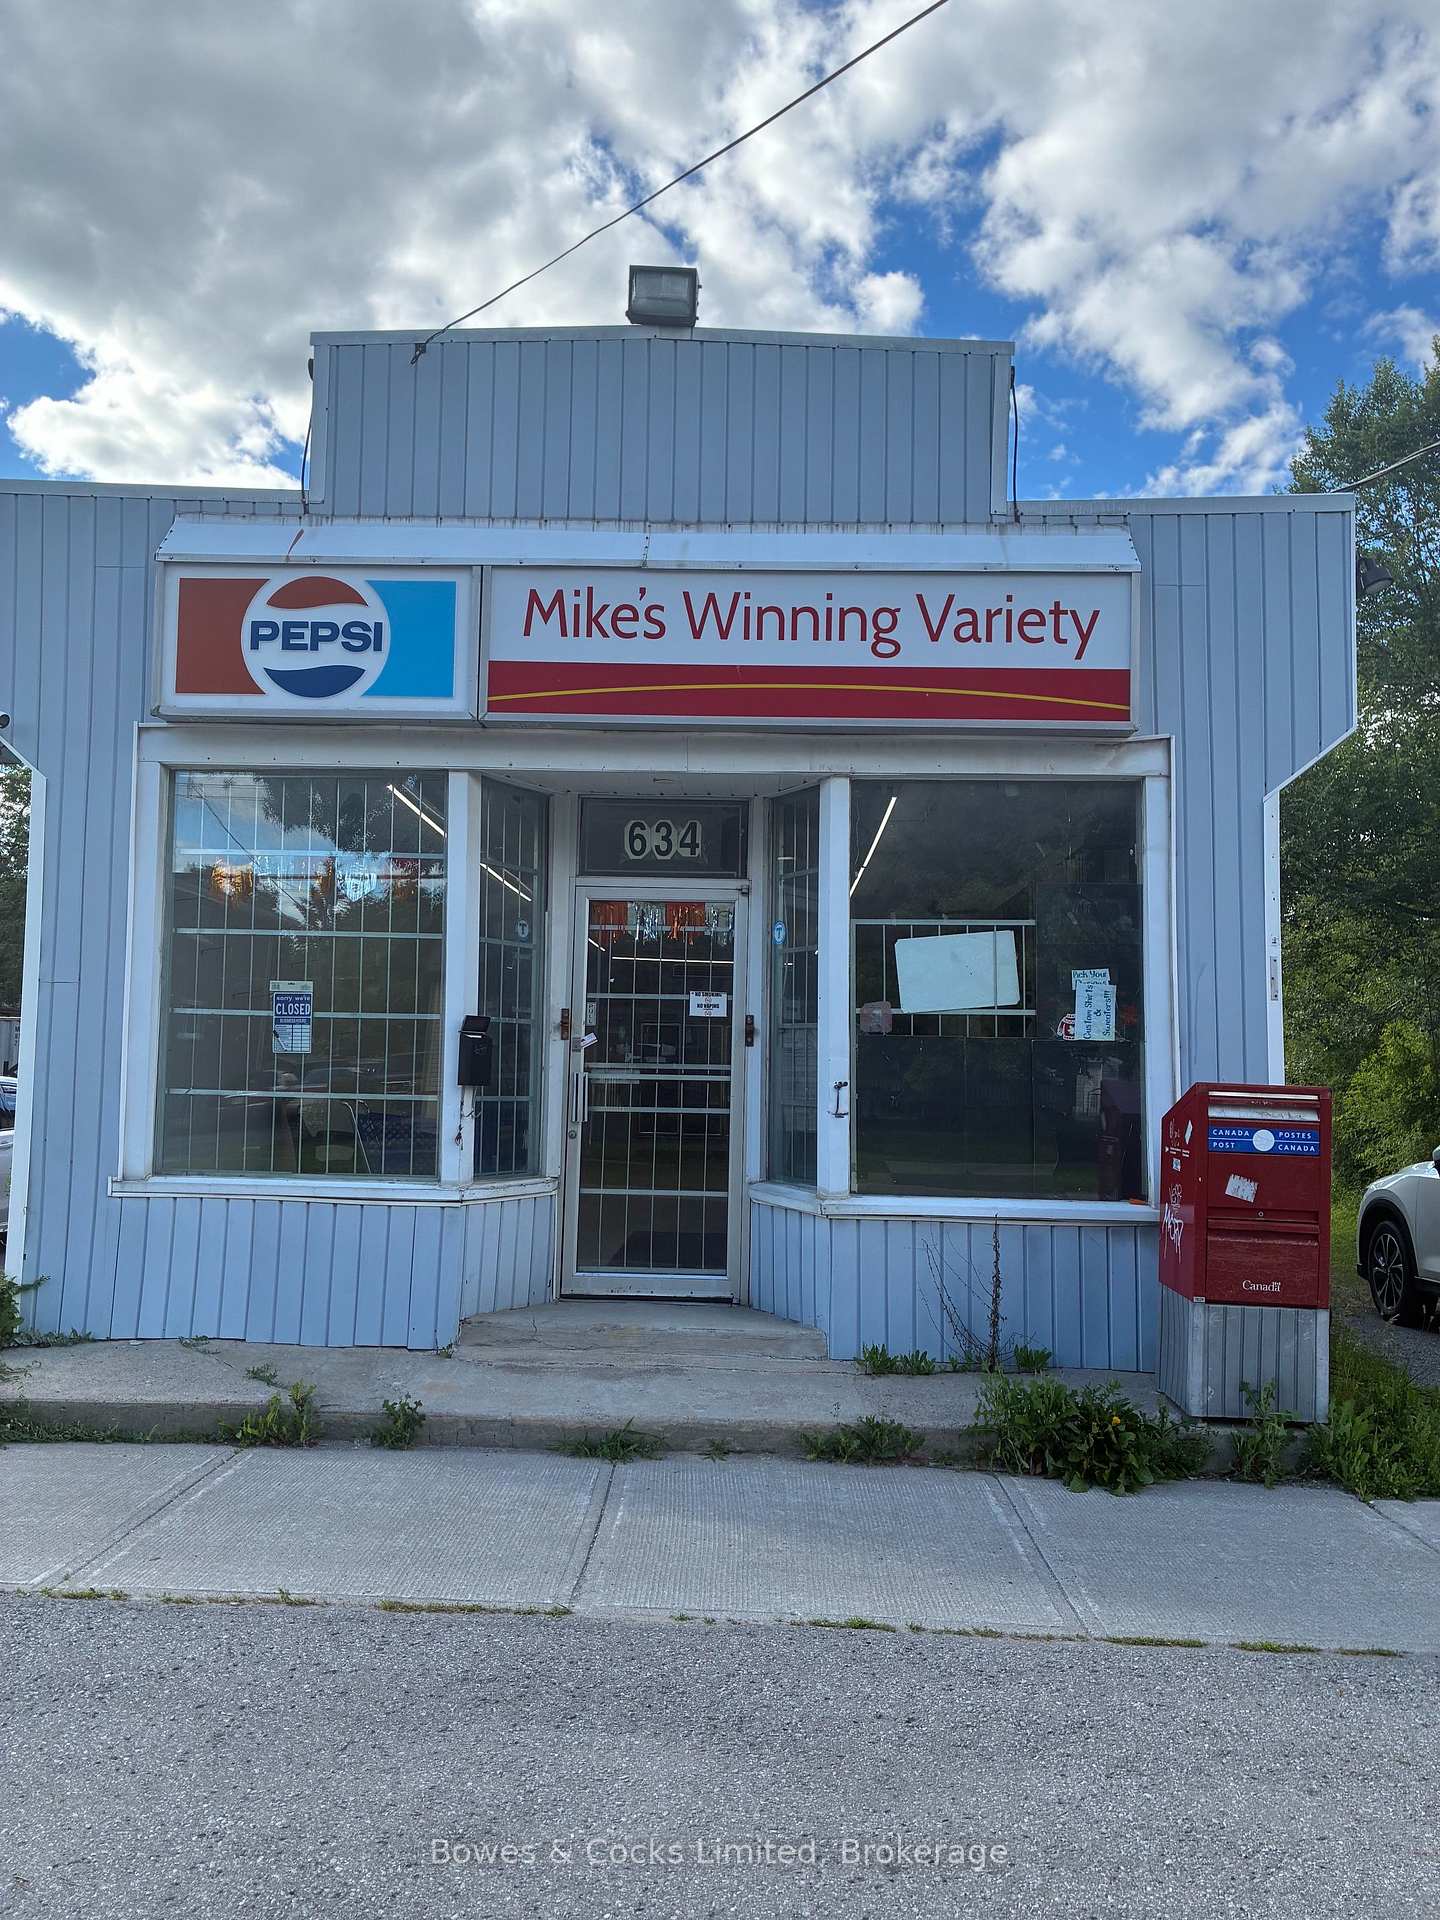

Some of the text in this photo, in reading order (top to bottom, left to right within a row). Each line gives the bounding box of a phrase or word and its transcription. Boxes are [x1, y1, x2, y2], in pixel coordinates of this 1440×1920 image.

[523, 586, 1101, 661] Mike's Winning Variety
[250, 620, 384, 652] PEPSI
[627, 820, 701, 858] 634
[275, 1003, 311, 1015] CLOSED
[1083, 1009, 1093, 1040] Custom
[1212, 1129, 1250, 1137] CANADA
[1278, 1131, 1312, 1139] POSTES
[1278, 1144, 1316, 1152] CANADA
[1242, 1280, 1281, 1292] Canada
